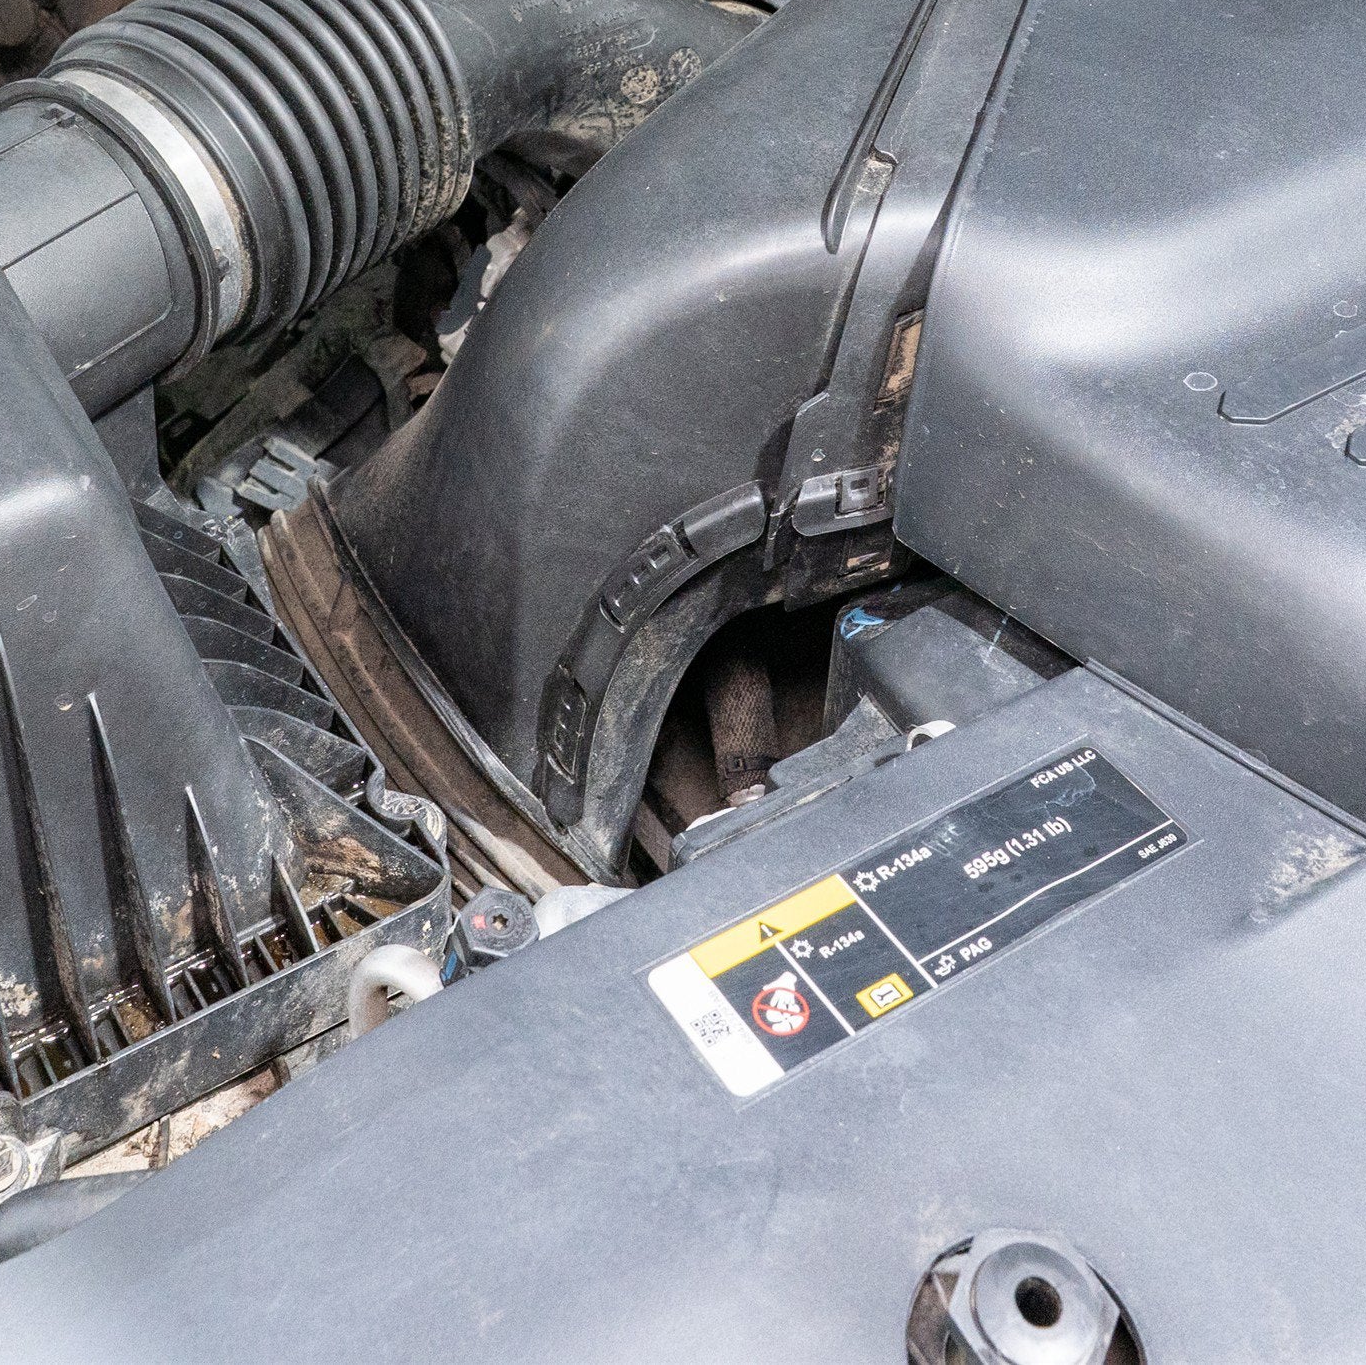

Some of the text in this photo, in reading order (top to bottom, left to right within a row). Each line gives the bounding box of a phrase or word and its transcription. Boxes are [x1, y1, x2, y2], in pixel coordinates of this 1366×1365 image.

[1030, 749, 1097, 789] FCA US LLC
[963, 816, 1073, 879] 595g (1.31 lb)
[1137, 833, 1178, 860] SAE J639
[875, 846, 933, 881] R-134a
[818, 930, 866, 959] R-134a
[959, 936, 993, 962] PAG
